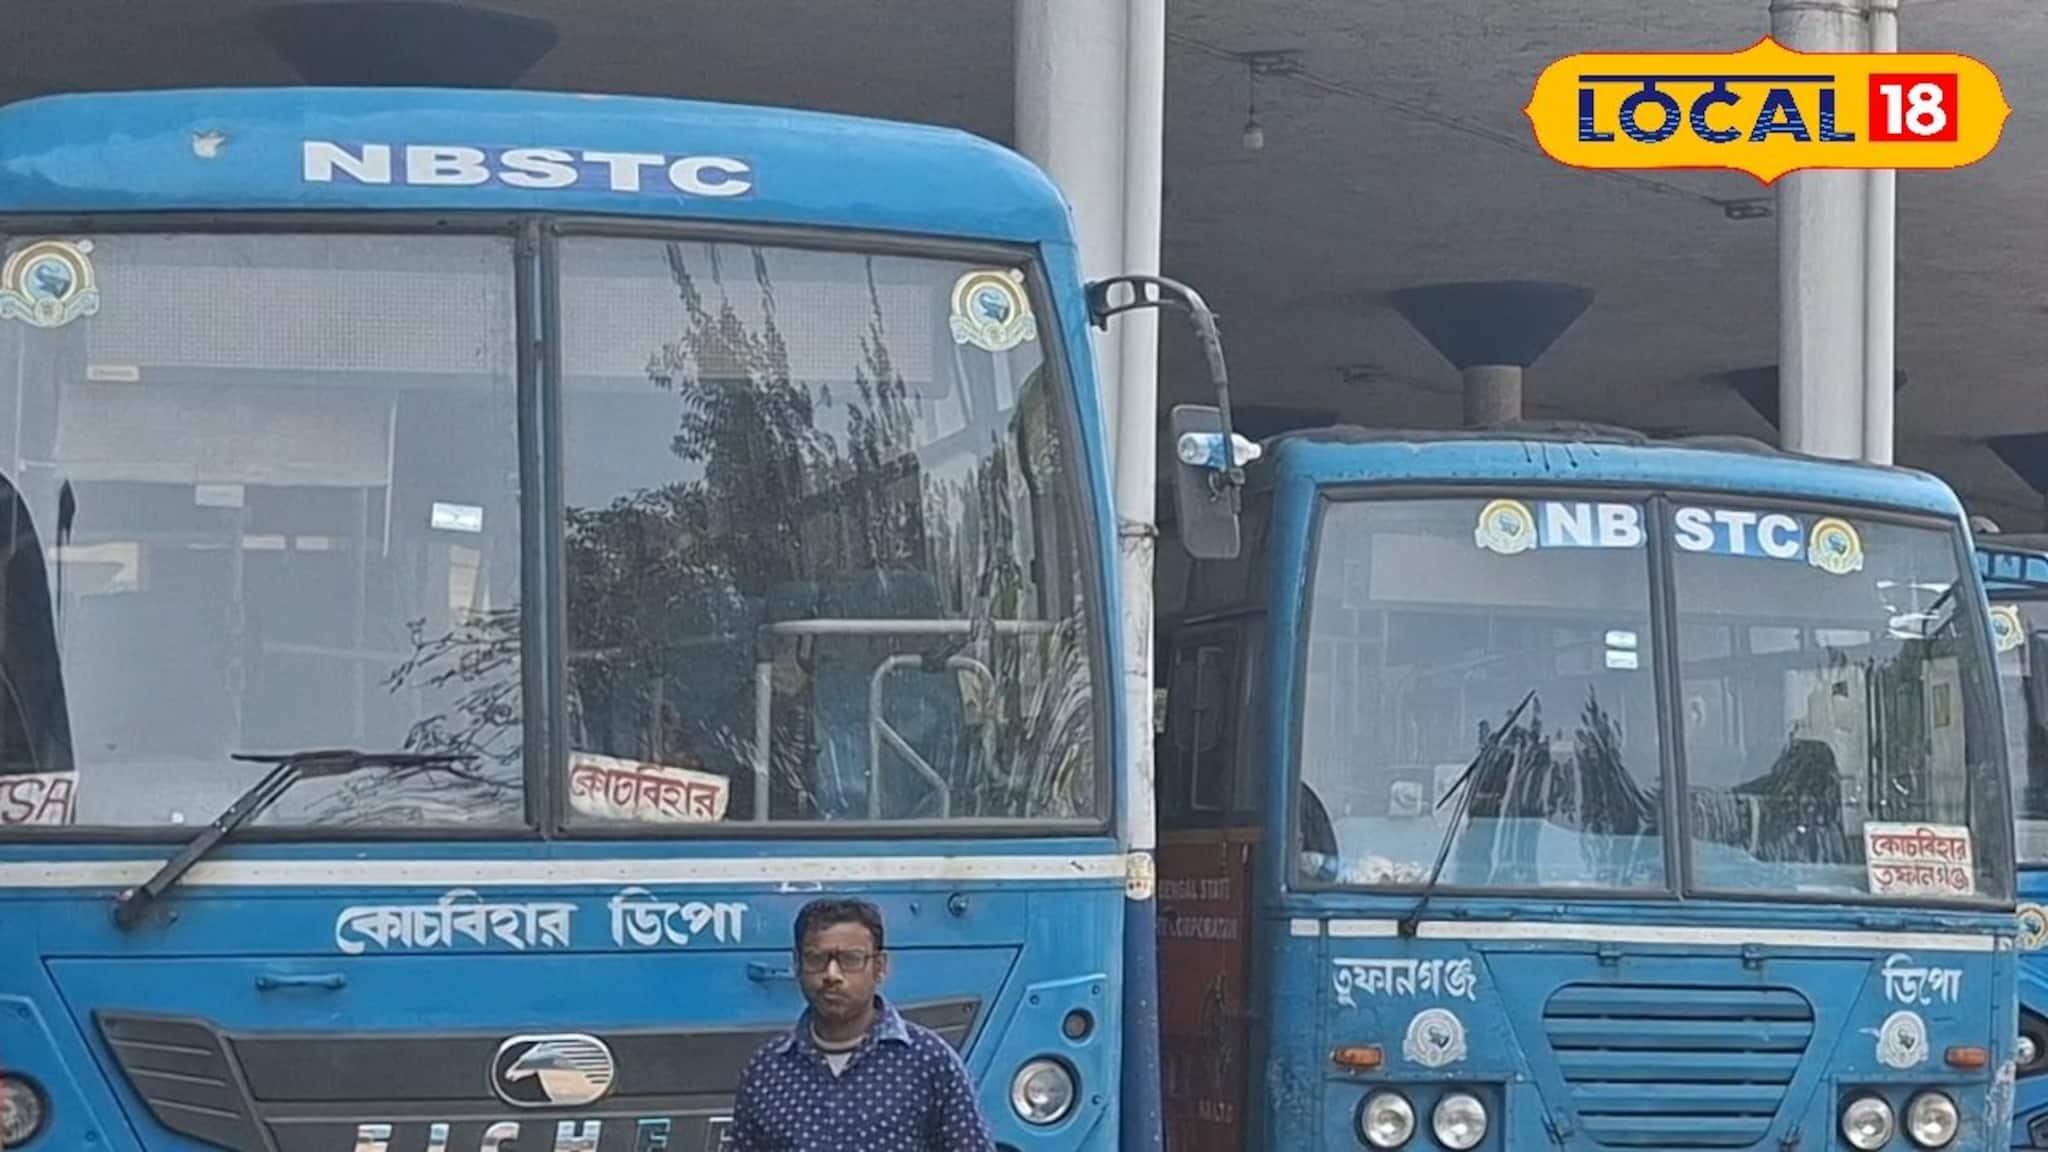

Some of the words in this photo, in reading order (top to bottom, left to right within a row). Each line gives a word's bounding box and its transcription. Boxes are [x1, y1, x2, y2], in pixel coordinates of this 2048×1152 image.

[303, 141, 754, 197] NBSTC
[1545, 501, 1643, 547] NB
[1674, 508, 1801, 559] STC
[1870, 827, 1967, 864] কোচবিহার
[335, 886, 579, 954] কোচবিহার
[607, 886, 748, 947] ডিপো
[1332, 957, 1478, 1009] তুফানগঞ্জ
[1881, 952, 1963, 1006] ডিপো
